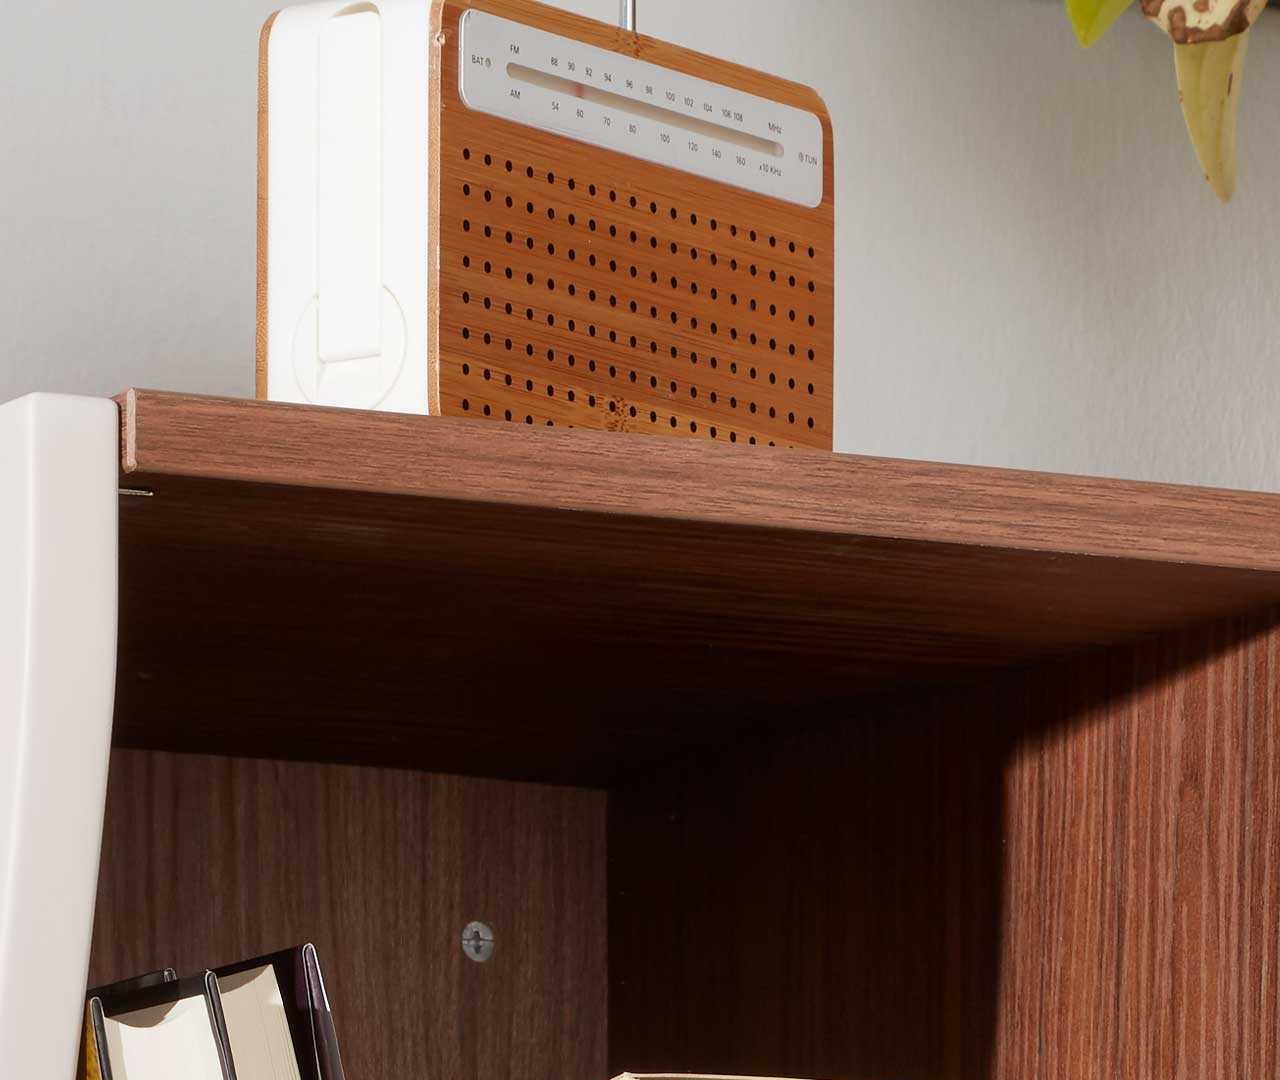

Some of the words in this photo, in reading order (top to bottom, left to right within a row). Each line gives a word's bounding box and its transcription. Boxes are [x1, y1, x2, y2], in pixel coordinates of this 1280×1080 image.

[509, 44, 520, 55] FM
[471, 54, 484, 65] BAT
[509, 89, 520, 99] AM
[585, 66, 593, 77] 92
[604, 72, 612, 82] 94
[665, 91, 676, 102] 100
[684, 97, 694, 108] 102
[703, 102, 713, 113] 104
[551, 102, 559, 111] 54
[603, 116, 611, 127] 70
[659, 133, 671, 143] 100
[688, 141, 698, 152] 120
[711, 148, 722, 158] 140
[804, 154, 818, 165] TUN
